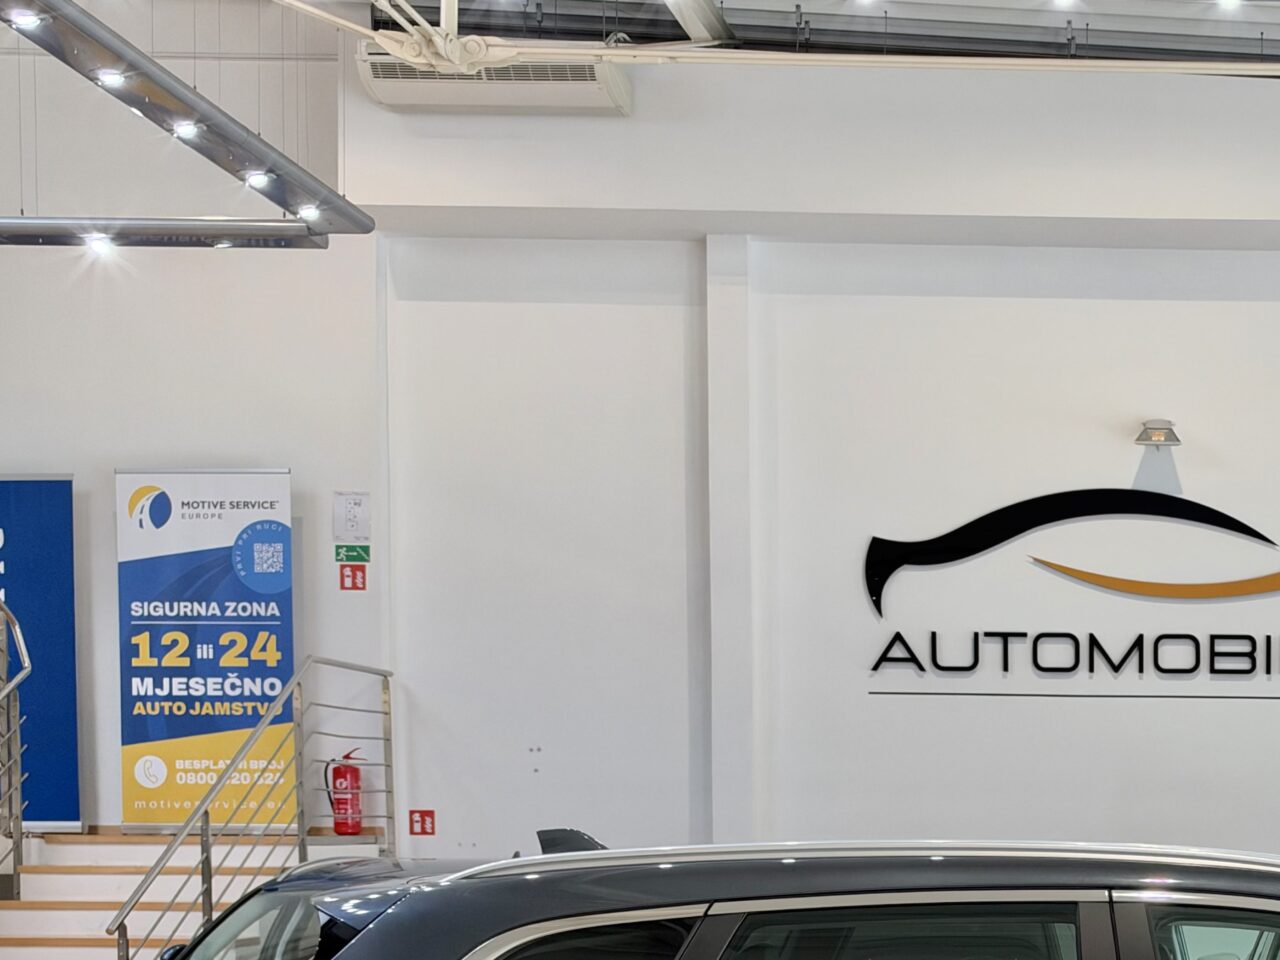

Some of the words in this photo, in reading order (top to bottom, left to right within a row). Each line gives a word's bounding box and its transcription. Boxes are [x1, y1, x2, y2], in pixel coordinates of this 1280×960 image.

[181, 500, 226, 510] MOTIVE
[181, 512, 223, 520] EUROPE
[130, 602, 221, 617] SIGURNA
[224, 602, 281, 617] ZONA
[131, 631, 190, 667] 12
[196, 644, 213, 659] ili
[218, 631, 282, 667] 24
[131, 673, 283, 697] MJESEČNO
[132, 701, 187, 715] AUTO
[176, 772, 218, 785] 0800
[221, 772, 250, 785] 20
